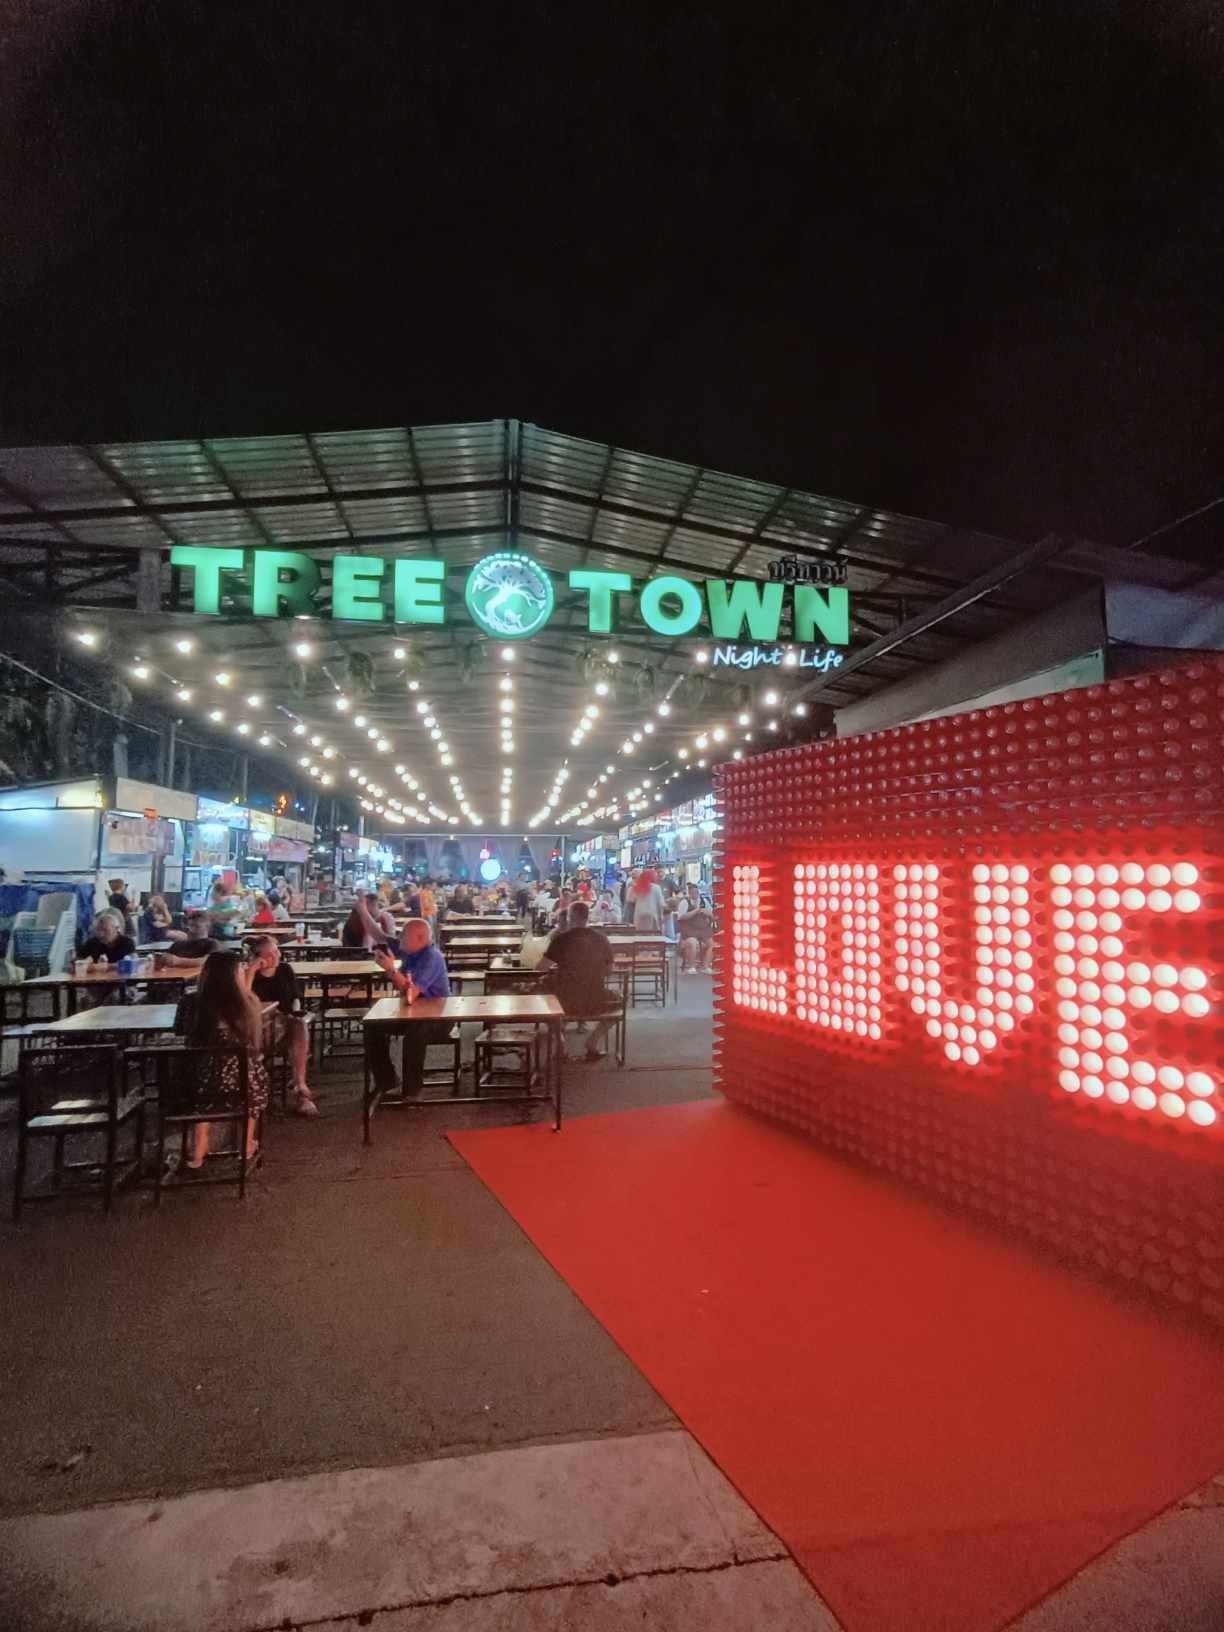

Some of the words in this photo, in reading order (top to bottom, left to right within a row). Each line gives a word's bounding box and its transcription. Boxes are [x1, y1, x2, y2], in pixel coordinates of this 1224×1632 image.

[171, 546, 446, 625] TREE
[568, 569, 850, 645] TOWN
[713, 646, 783, 672] Night
[799, 649, 845, 676] Life
[732, 862, 1217, 1127] LOVE
